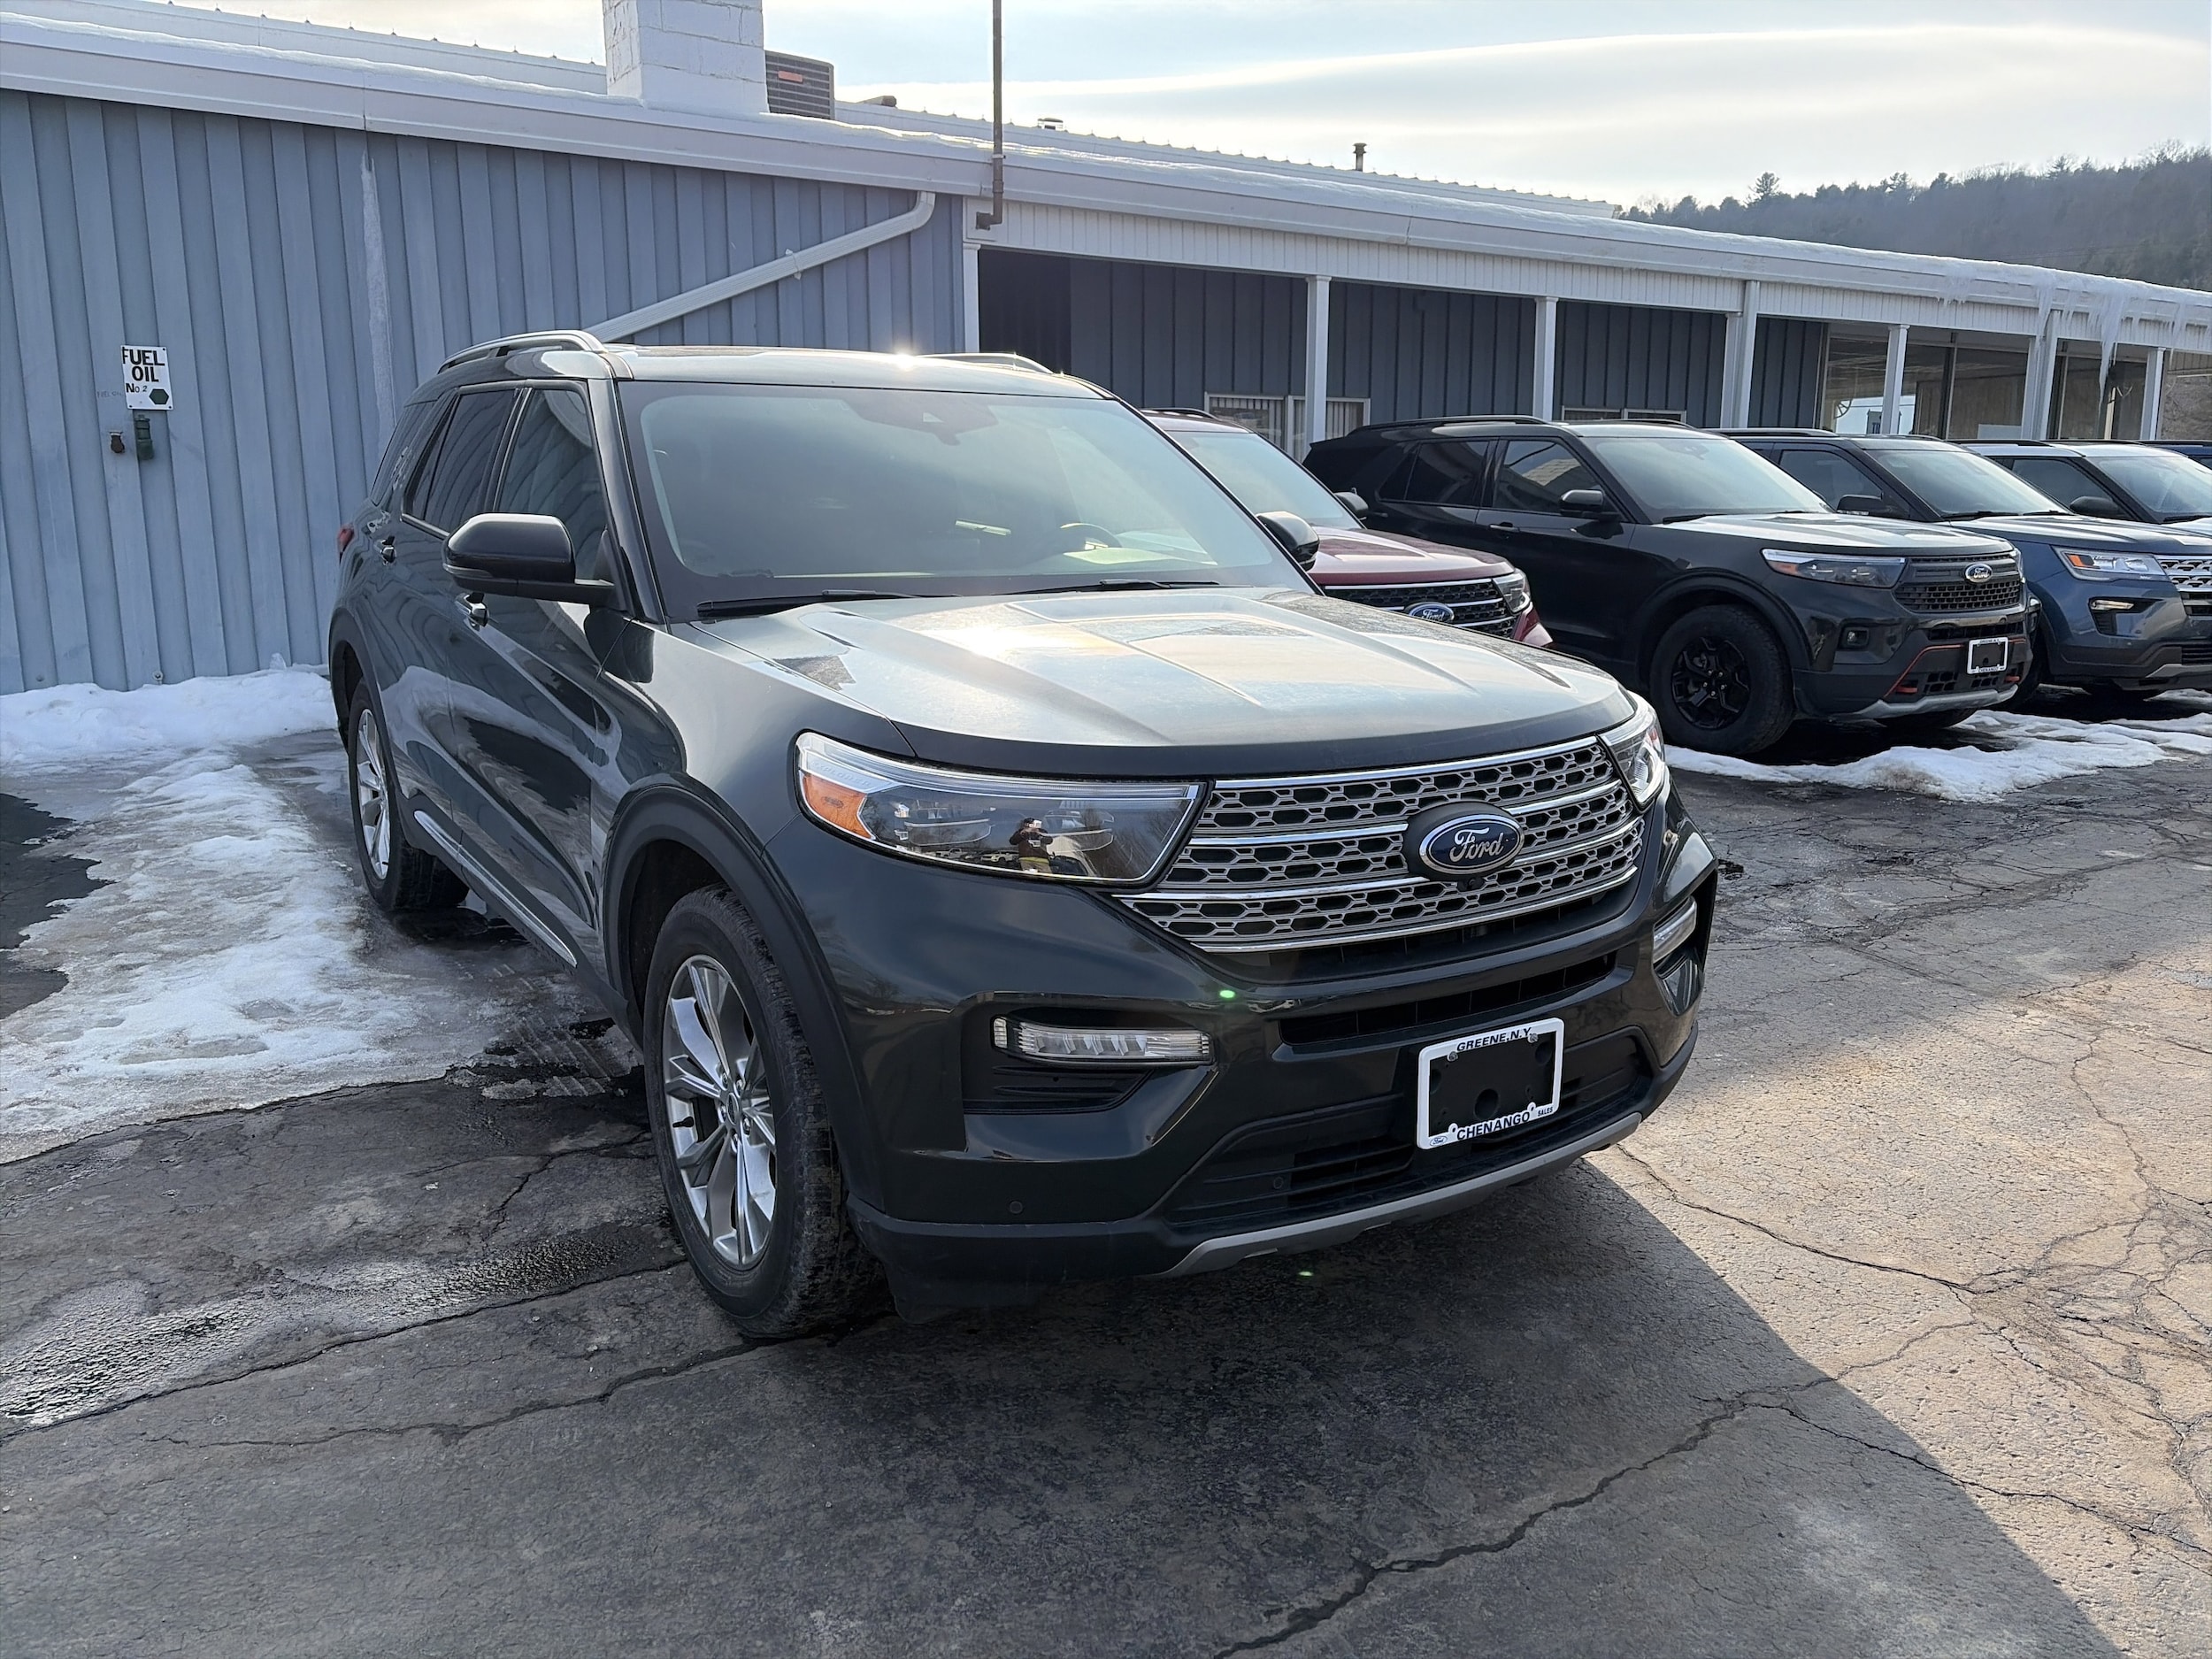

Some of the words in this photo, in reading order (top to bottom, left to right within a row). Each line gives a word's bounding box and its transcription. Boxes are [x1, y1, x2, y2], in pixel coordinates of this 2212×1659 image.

[122, 347, 165, 366] FUEL
[131, 365, 159, 382] OIL
[1974, 567, 1990, 578] Ford
[1422, 609, 1445, 620] Ford
[1449, 827, 1504, 863] Ford
[1456, 1111, 1531, 1141] CHENANGO
[1538, 1107, 1554, 1117] SALES
